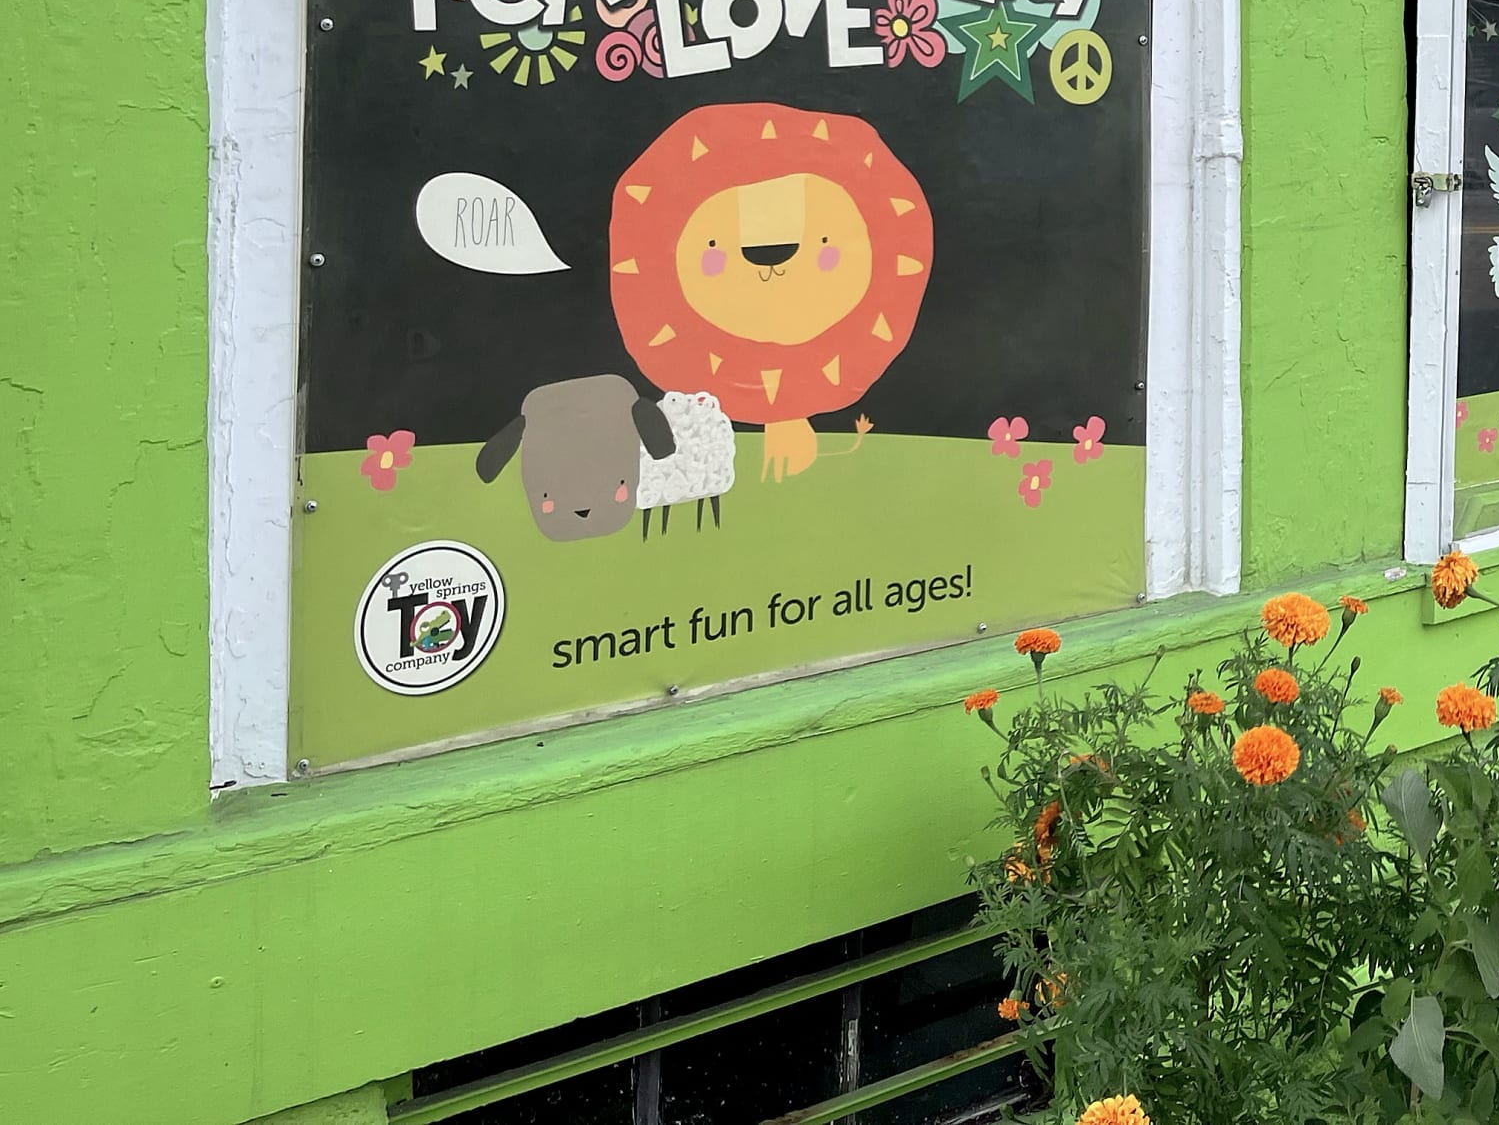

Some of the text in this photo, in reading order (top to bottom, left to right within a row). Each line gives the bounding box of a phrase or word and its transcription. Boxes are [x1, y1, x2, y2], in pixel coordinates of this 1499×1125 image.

[454, 196, 516, 248] ROAR
[409, 577, 453, 596] yellow
[436, 581, 486, 599] springs
[552, 565, 973, 668] smart fun for all ages!
[385, 652, 450, 672] company
